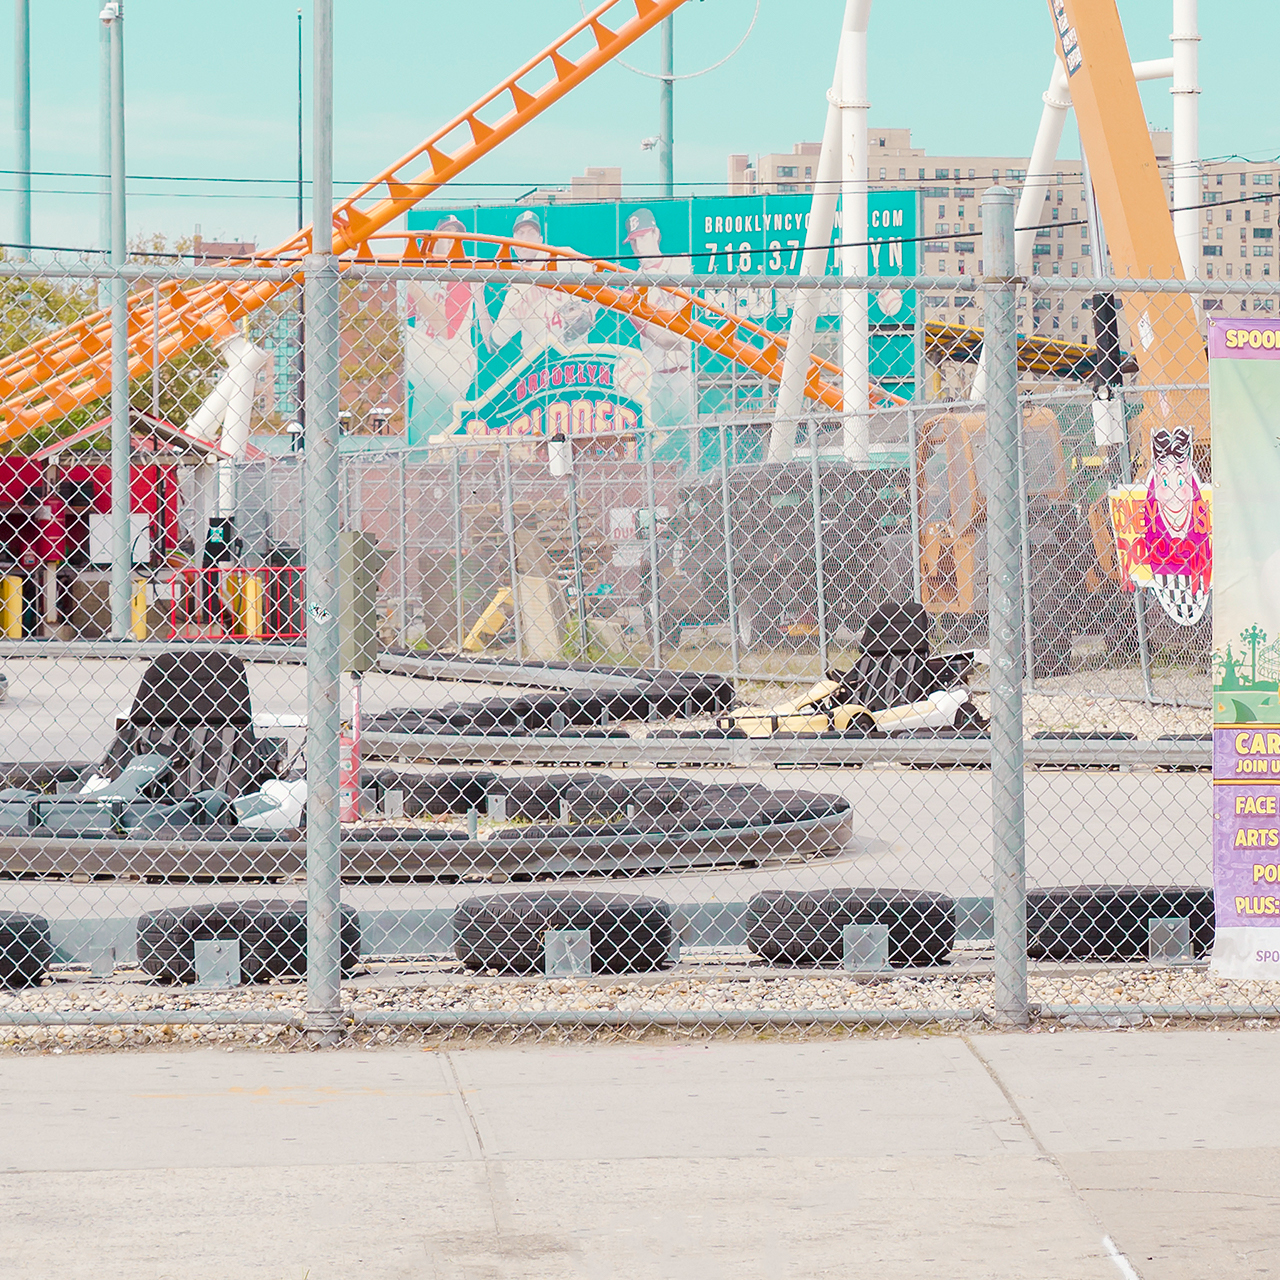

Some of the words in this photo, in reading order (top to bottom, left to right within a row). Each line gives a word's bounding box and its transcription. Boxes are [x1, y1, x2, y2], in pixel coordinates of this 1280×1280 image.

[516, 364, 610, 401] BROOKLYN
[1235, 759, 1268, 773] JOIN
[1235, 796, 1276, 815] FACE
[1235, 828, 1279, 847] ARTS
[1234, 896, 1280, 915] PLUS:
